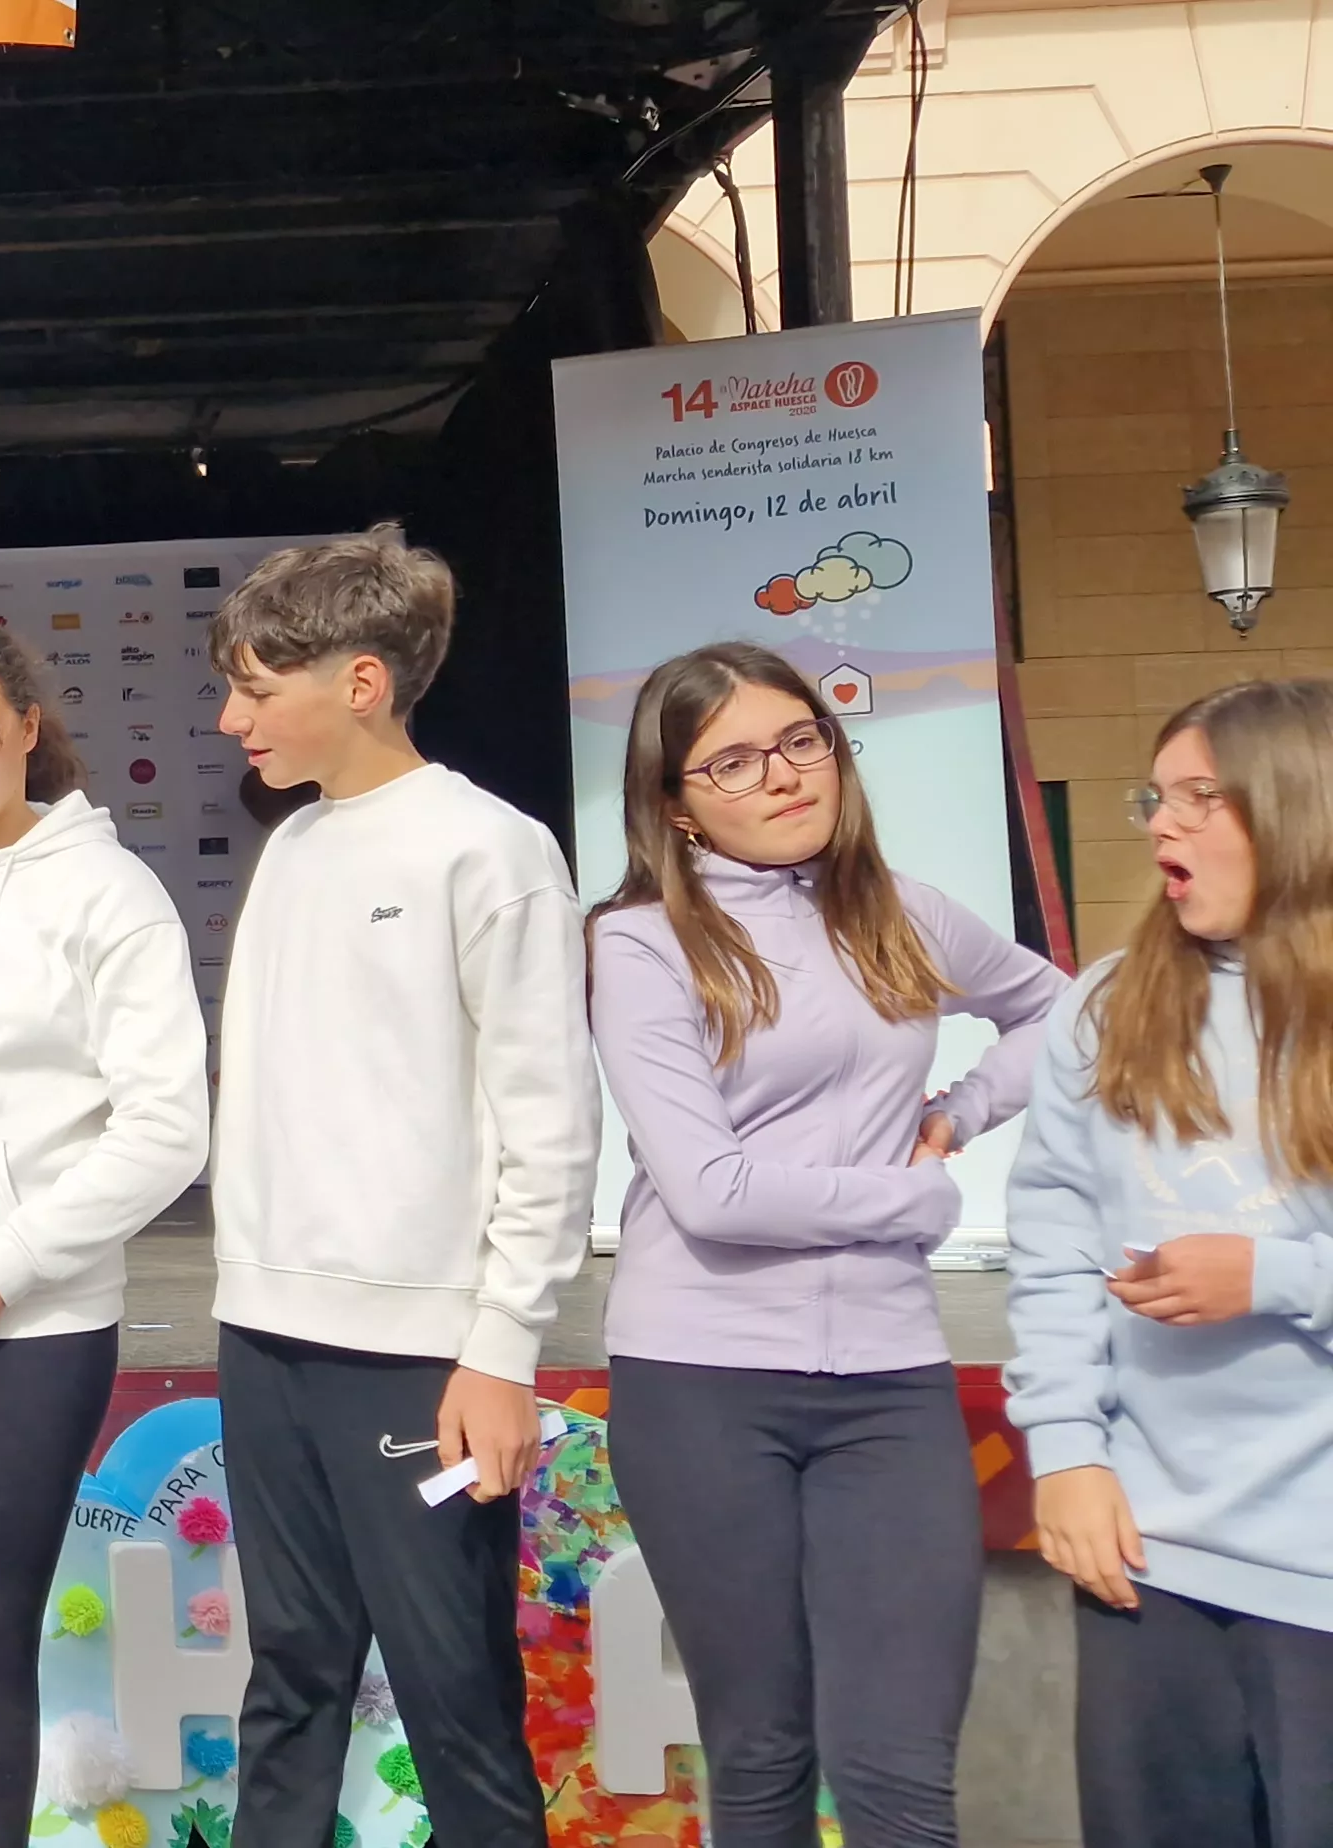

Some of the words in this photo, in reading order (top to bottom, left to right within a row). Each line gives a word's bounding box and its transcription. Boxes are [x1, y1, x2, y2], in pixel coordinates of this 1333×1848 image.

[661, 379, 719, 422] 14
[727, 372, 817, 400] Marcha
[730, 399, 772, 413] ASPACE
[774, 394, 817, 409] HUESCA
[643, 466, 696, 486] Marcha
[701, 460, 773, 480] senderista
[778, 452, 842, 473] solidaria
[848, 448, 862, 465] 18
[869, 446, 893, 462] km
[655, 444, 704, 461] Palacio
[709, 439, 726, 454] de
[731, 435, 799, 456] Congresos
[804, 429, 822, 444] de
[828, 426, 877, 442] Huesca
[643, 500, 755, 531] Domingo,
[766, 493, 789, 518] 12
[798, 488, 828, 514] de
[837, 480, 898, 510] abril
[73, 1503, 142, 1538] UERTE
[148, 1466, 209, 1527] PARA
